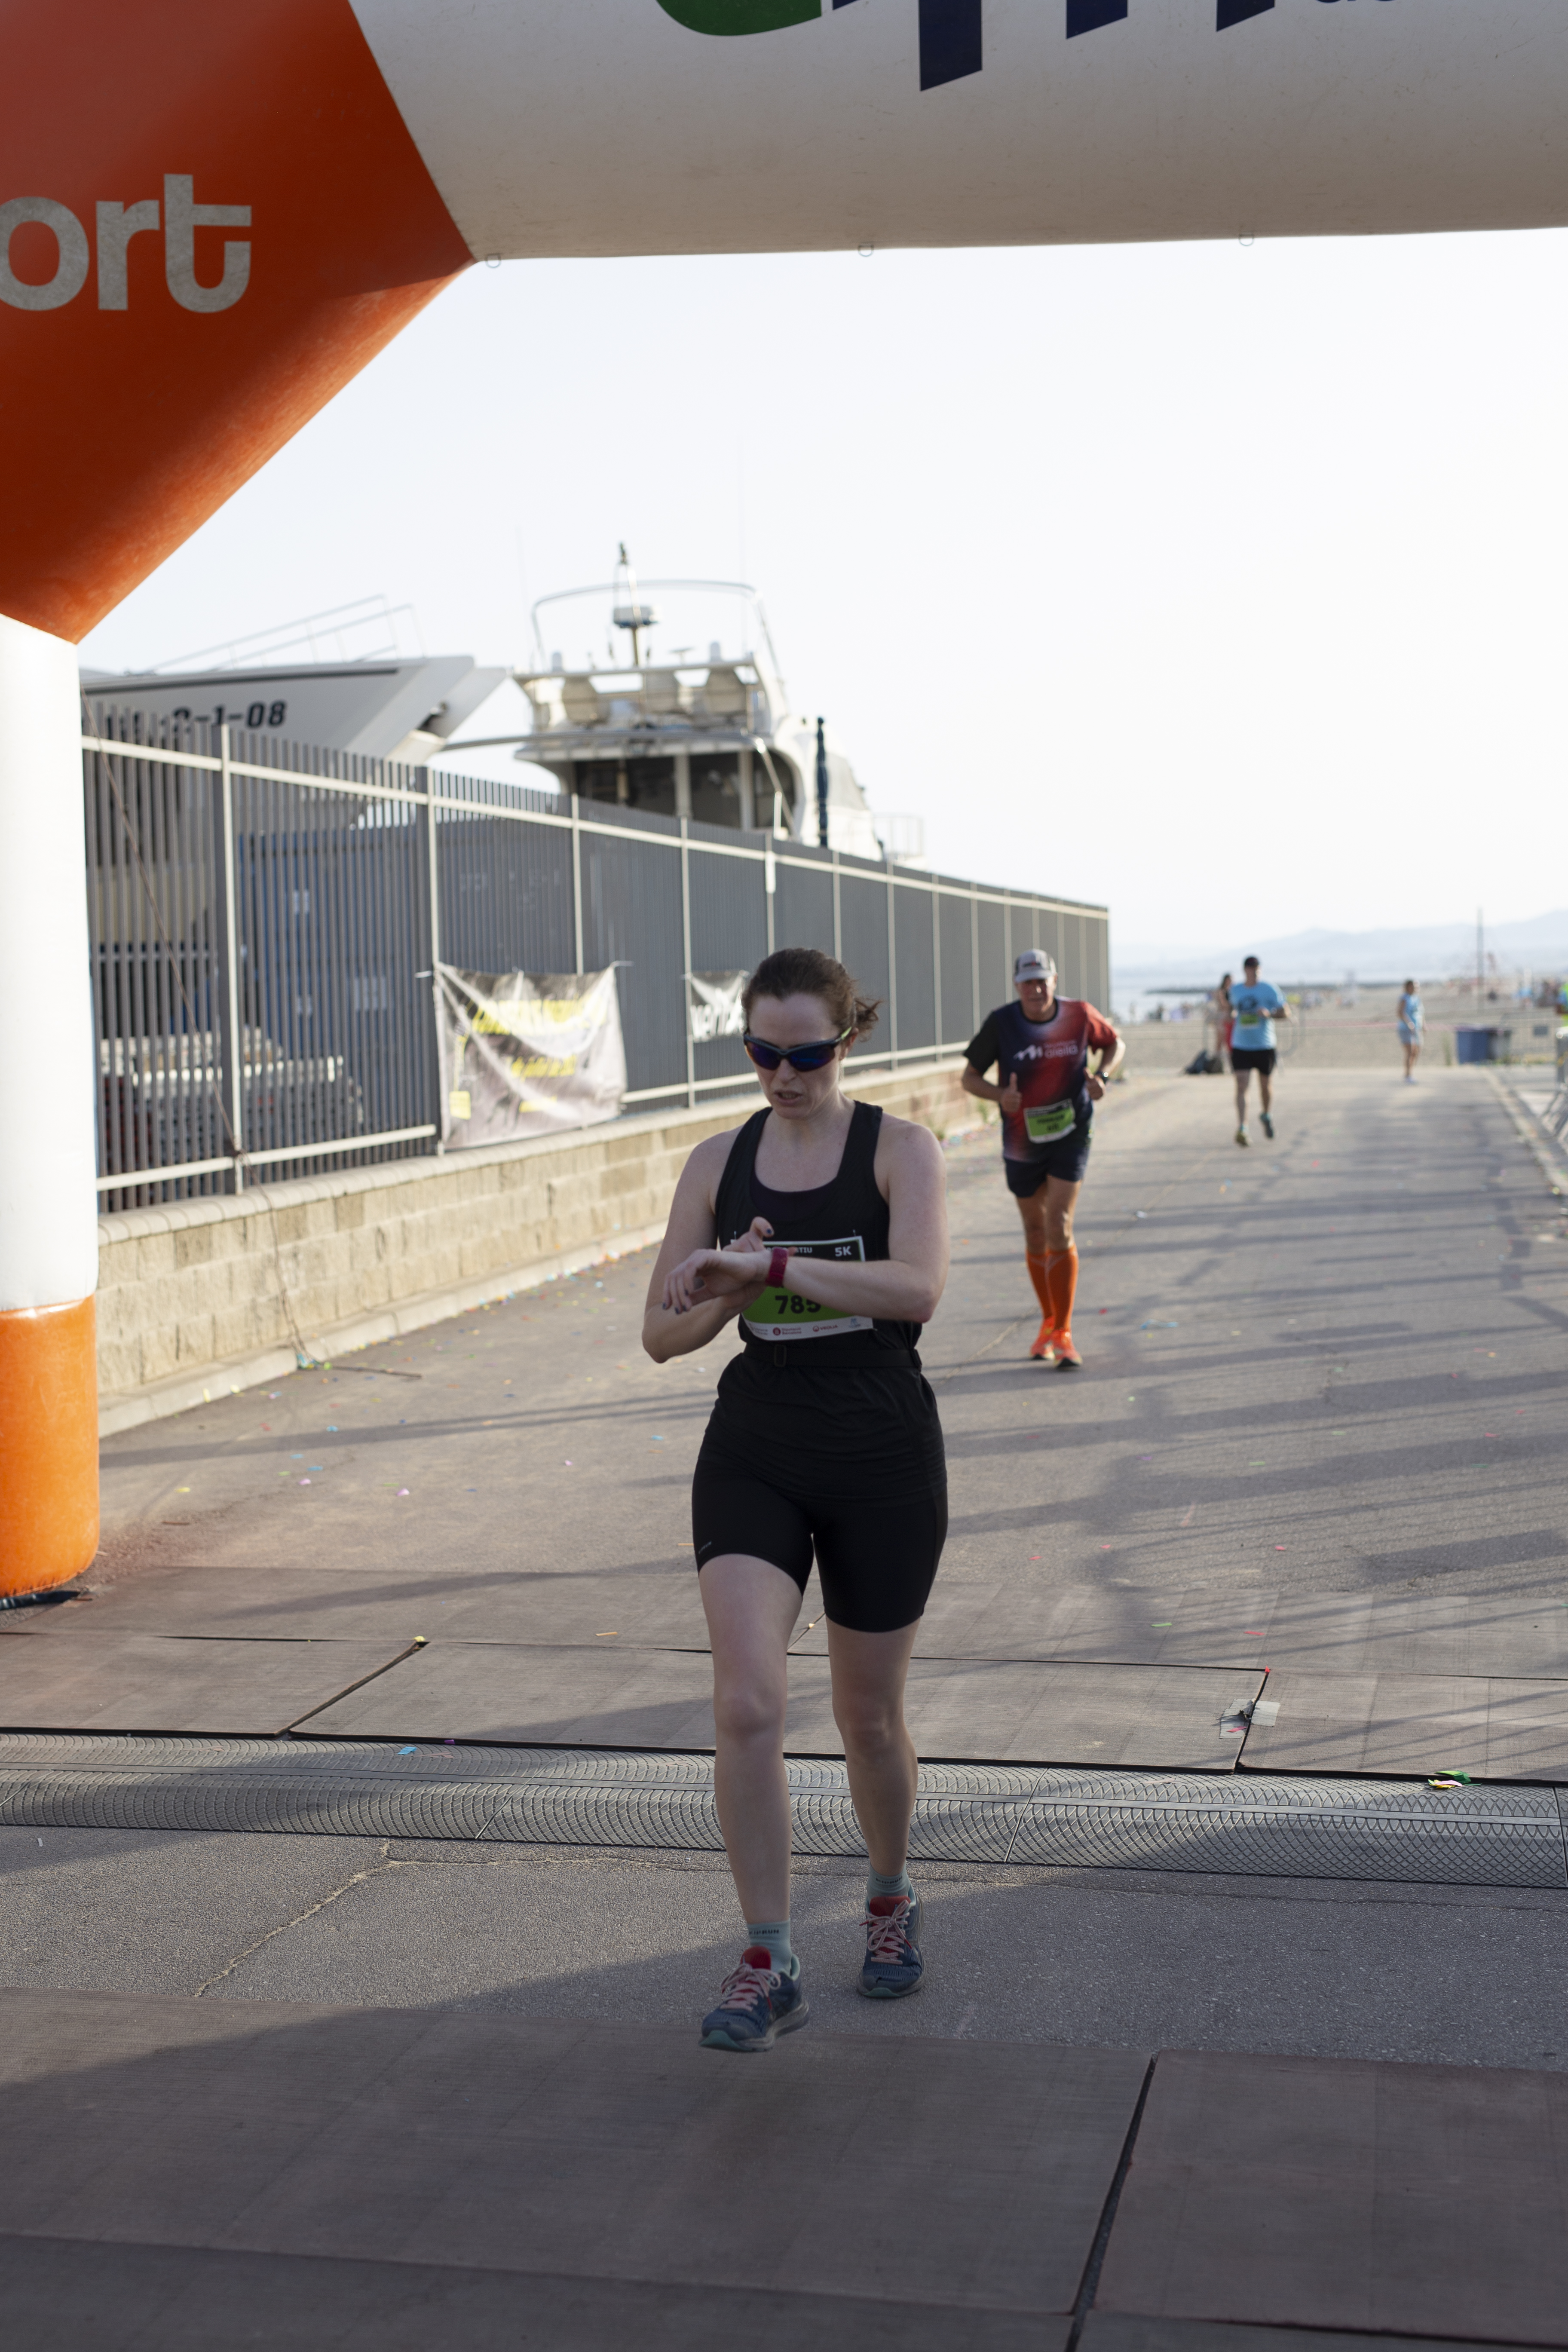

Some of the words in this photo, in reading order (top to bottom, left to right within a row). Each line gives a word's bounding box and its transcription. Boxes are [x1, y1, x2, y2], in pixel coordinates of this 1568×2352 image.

[0, 174, 252, 313] ort
[835, 1246, 852, 1257] 5K
[775, 1295, 821, 1314] 785
